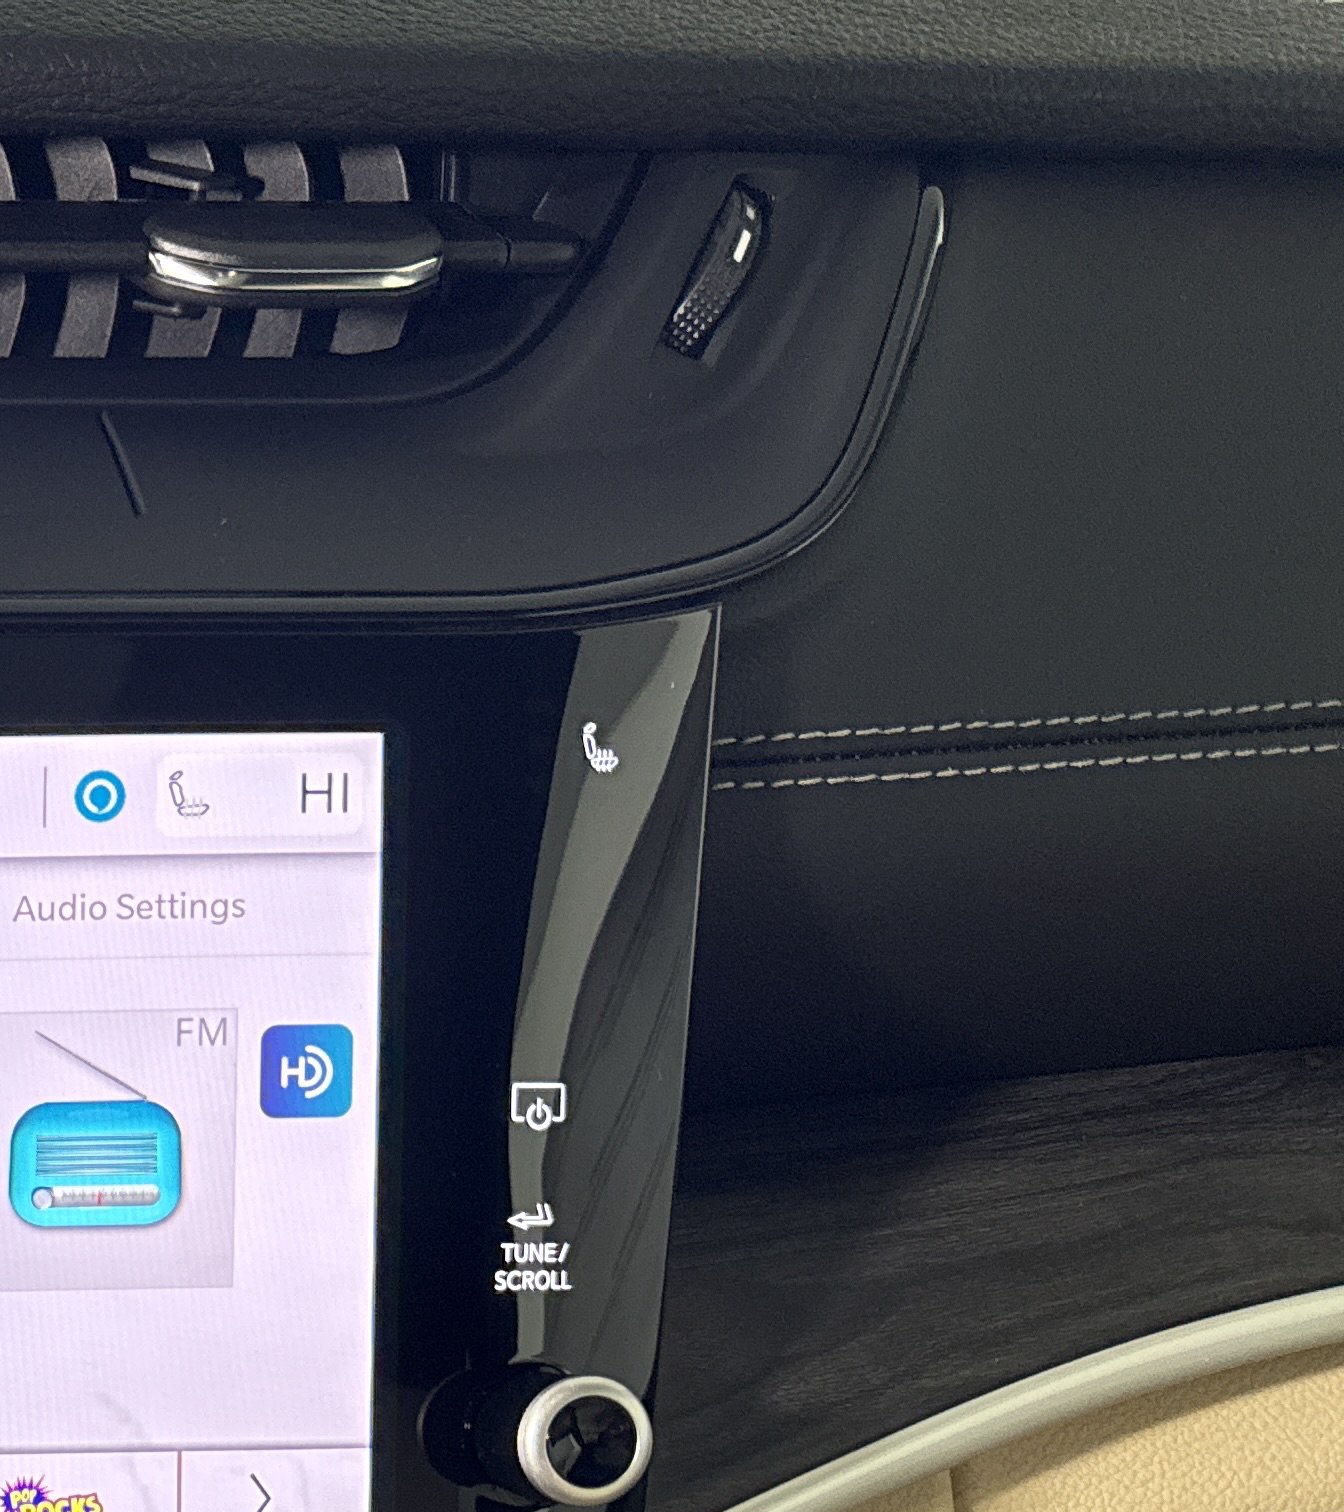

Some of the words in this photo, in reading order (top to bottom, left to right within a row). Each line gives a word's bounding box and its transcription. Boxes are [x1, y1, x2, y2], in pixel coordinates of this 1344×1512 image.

[301, 772, 350, 814] HI
[12, 892, 108, 923] Audio
[115, 889, 247, 926] Settings
[175, 1017, 229, 1048] FM
[500, 1242, 571, 1264] TUNE/
[494, 1270, 573, 1291] SCROLL
